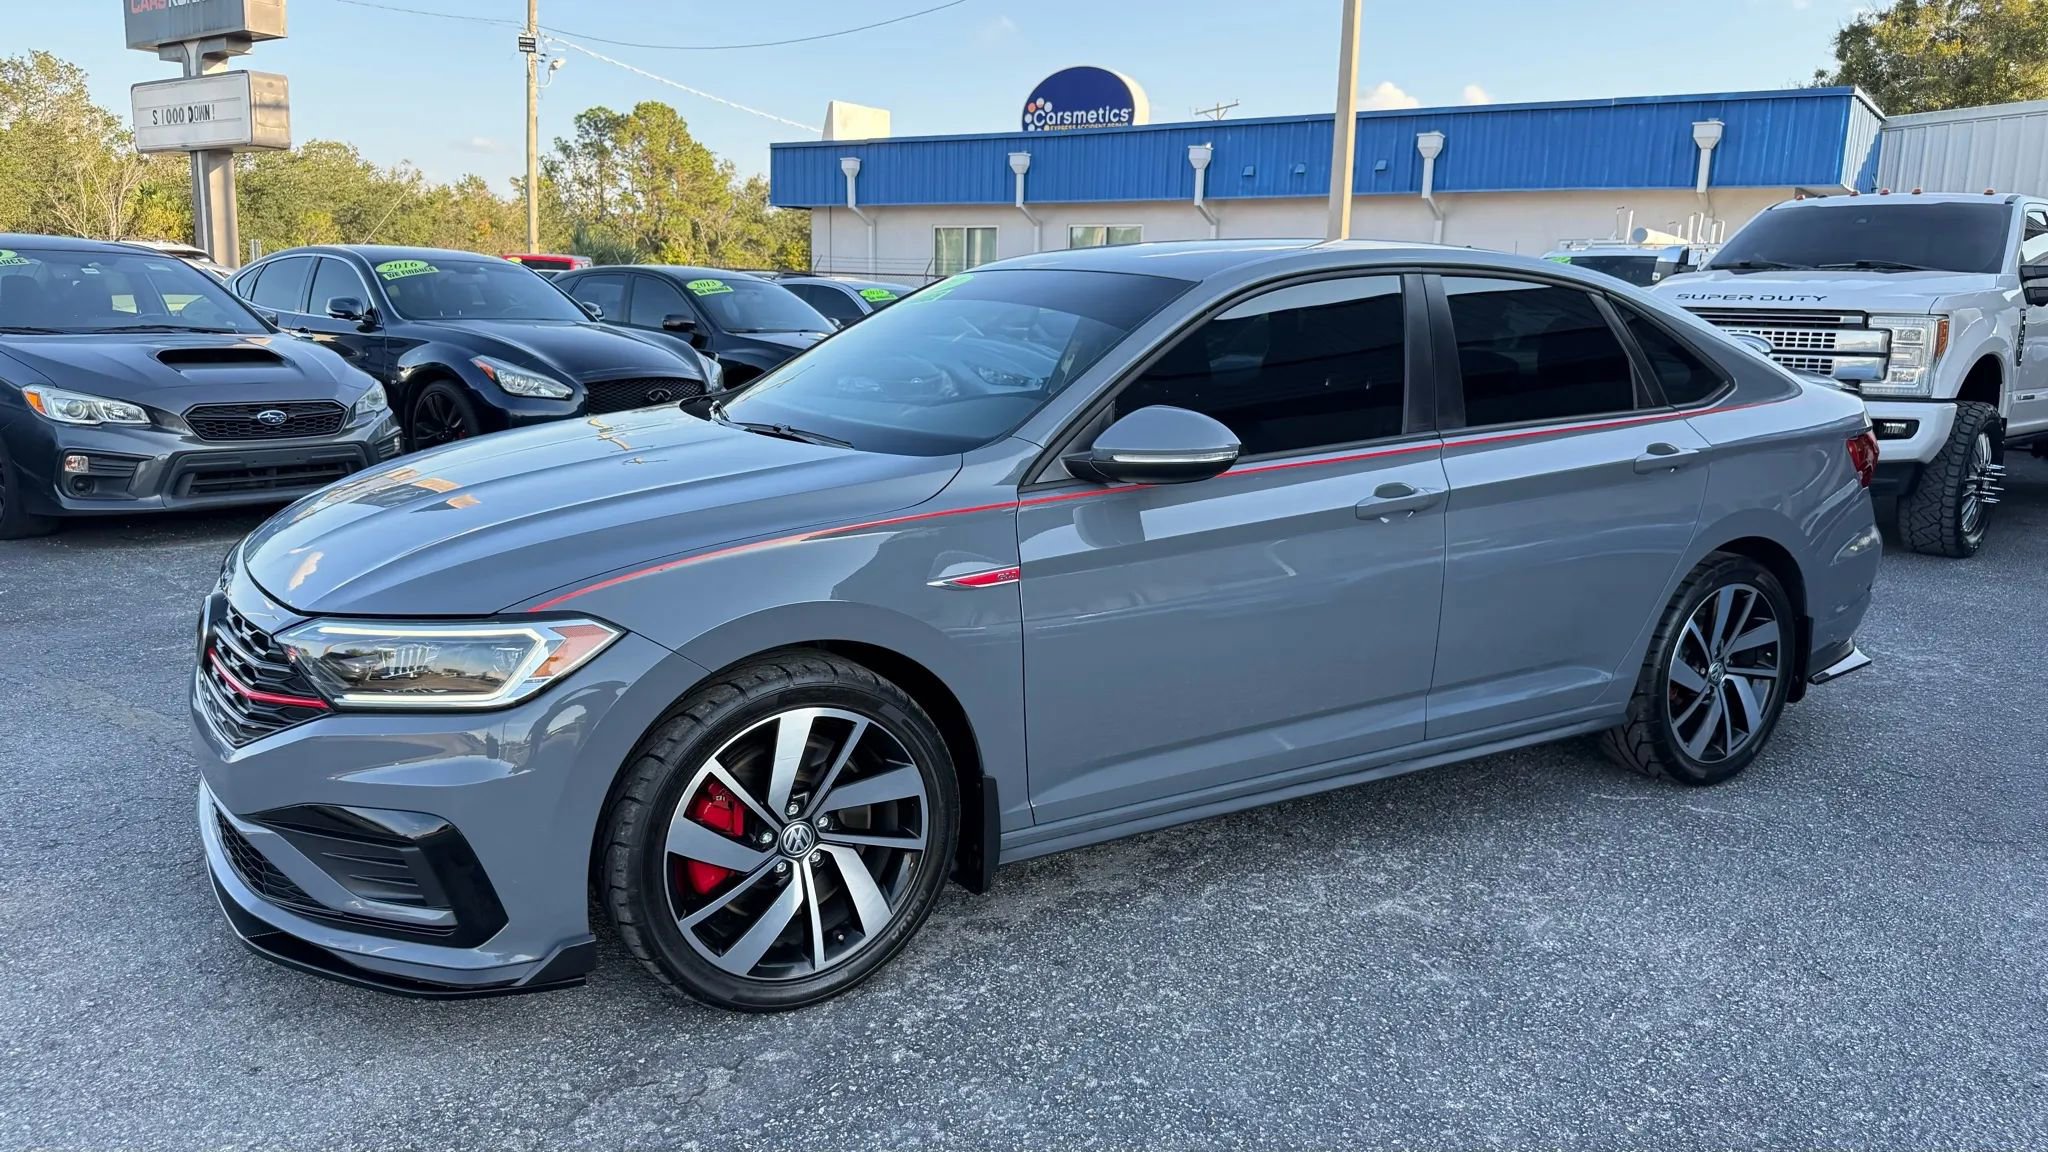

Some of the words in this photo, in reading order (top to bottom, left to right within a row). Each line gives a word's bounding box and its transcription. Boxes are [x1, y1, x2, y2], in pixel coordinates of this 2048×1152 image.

[1033, 105, 1129, 126] Carsmetics
[385, 262, 418, 271] 2016
[1676, 293, 1754, 301] SUPER
